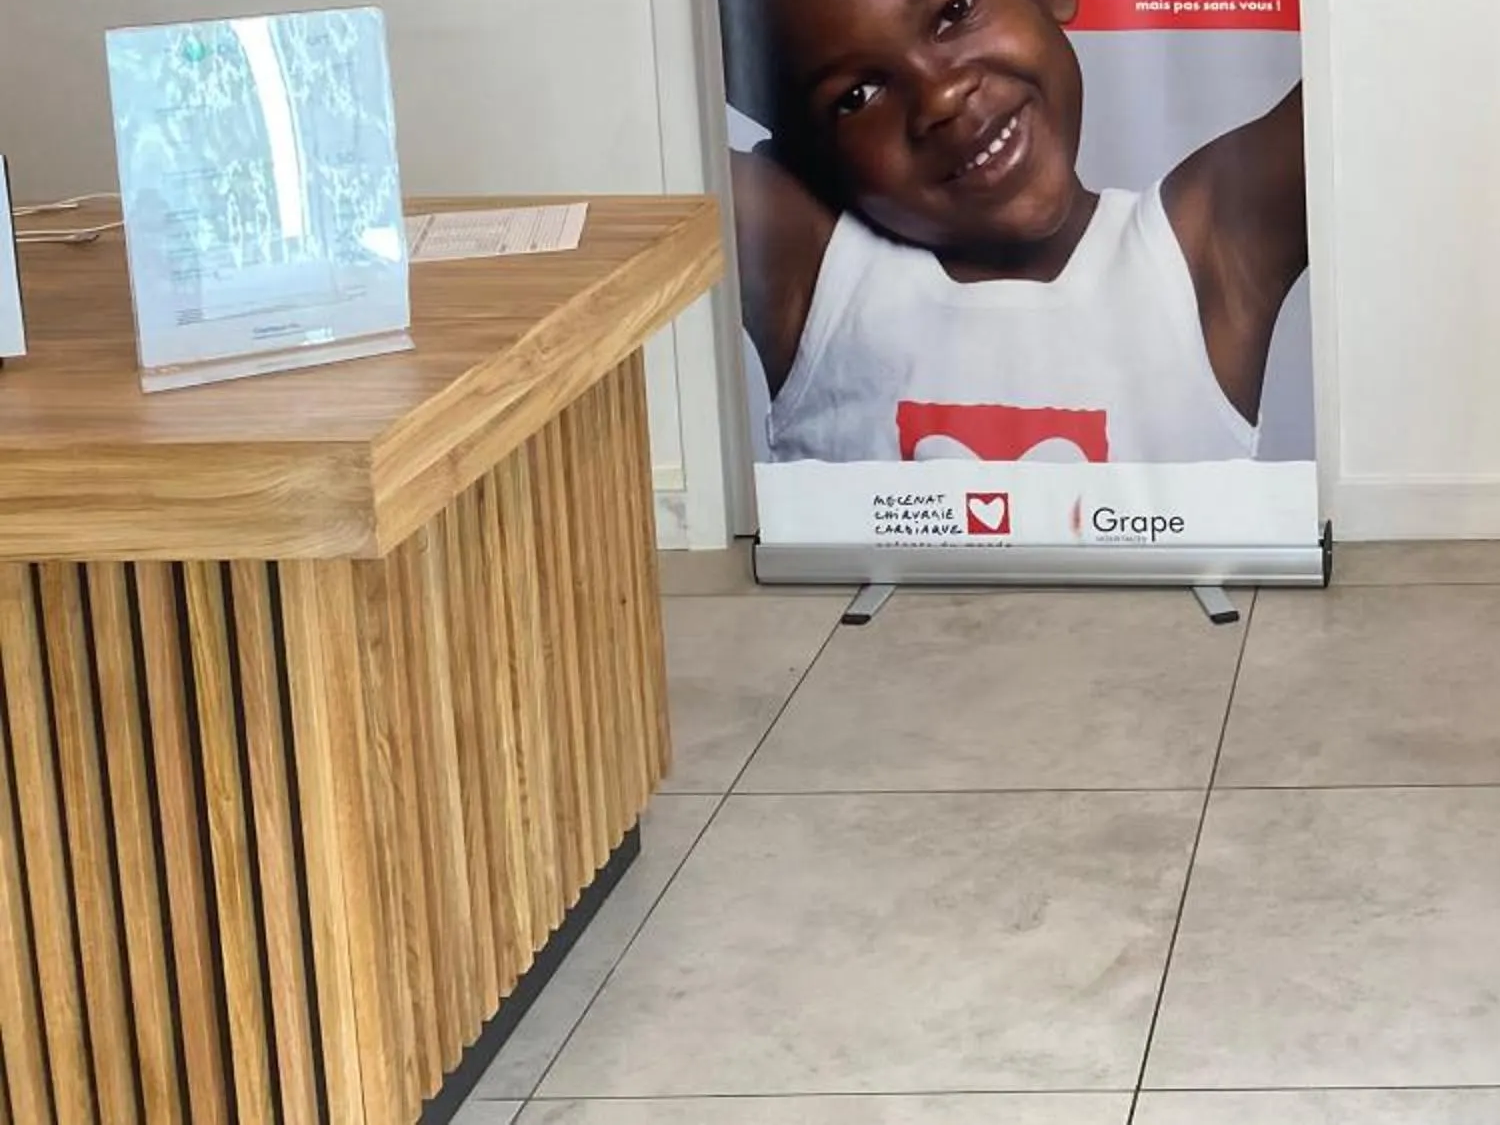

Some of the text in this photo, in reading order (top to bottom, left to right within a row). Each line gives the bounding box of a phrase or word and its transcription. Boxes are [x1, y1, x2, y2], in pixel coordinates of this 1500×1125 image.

[1173, 0, 1200, 15] pas
[1203, 0, 1236, 11] sans
[1240, 0, 1273, 11] vous
[1092, 506, 1185, 542] Grape
